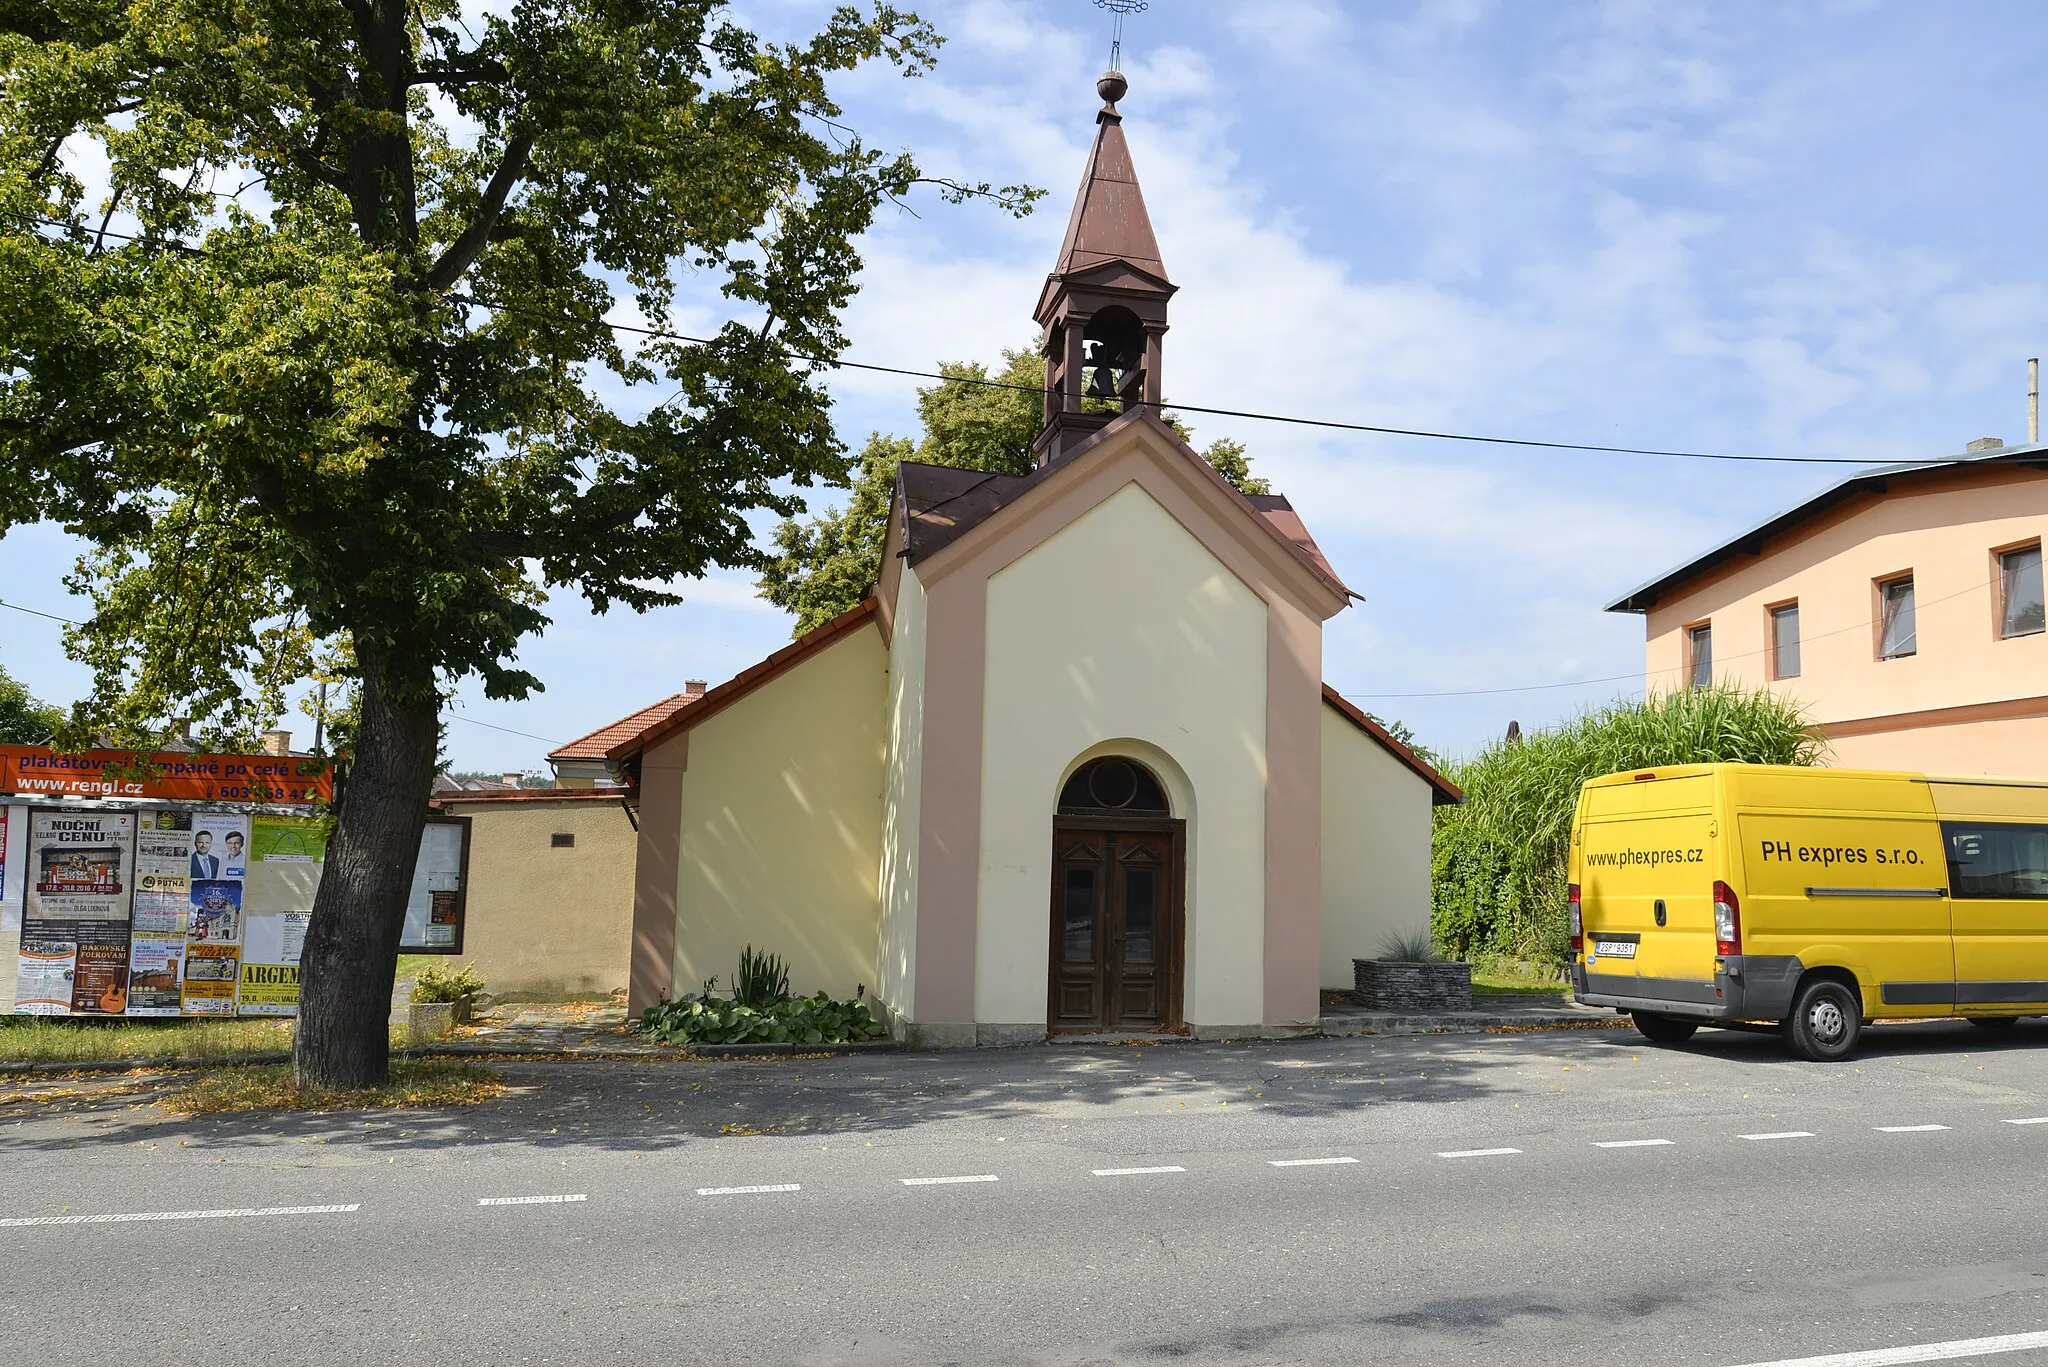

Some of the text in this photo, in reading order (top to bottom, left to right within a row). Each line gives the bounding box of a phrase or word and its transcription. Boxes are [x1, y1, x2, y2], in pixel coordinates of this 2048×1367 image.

[20, 753, 129, 772] plakátoví
[225, 764, 247, 778] po
[253, 761, 289, 777] celé
[16, 778, 144, 795] www.rengl.cz
[220, 786, 249, 799] 603
[51, 819, 102, 831] NOČNÍ
[59, 831, 106, 842] CENU
[1587, 848, 1703, 869] www.phexpres.cz
[1761, 840, 1925, 868] PH expres s.r.o.
[76, 884, 91, 892] 2016
[157, 879, 184, 887] PUTNA
[82, 943, 127, 952] BAKOVSKÉ
[1601, 943, 1613, 953] 2SP
[80, 950, 127, 959] FOLKOVÁNÍ
